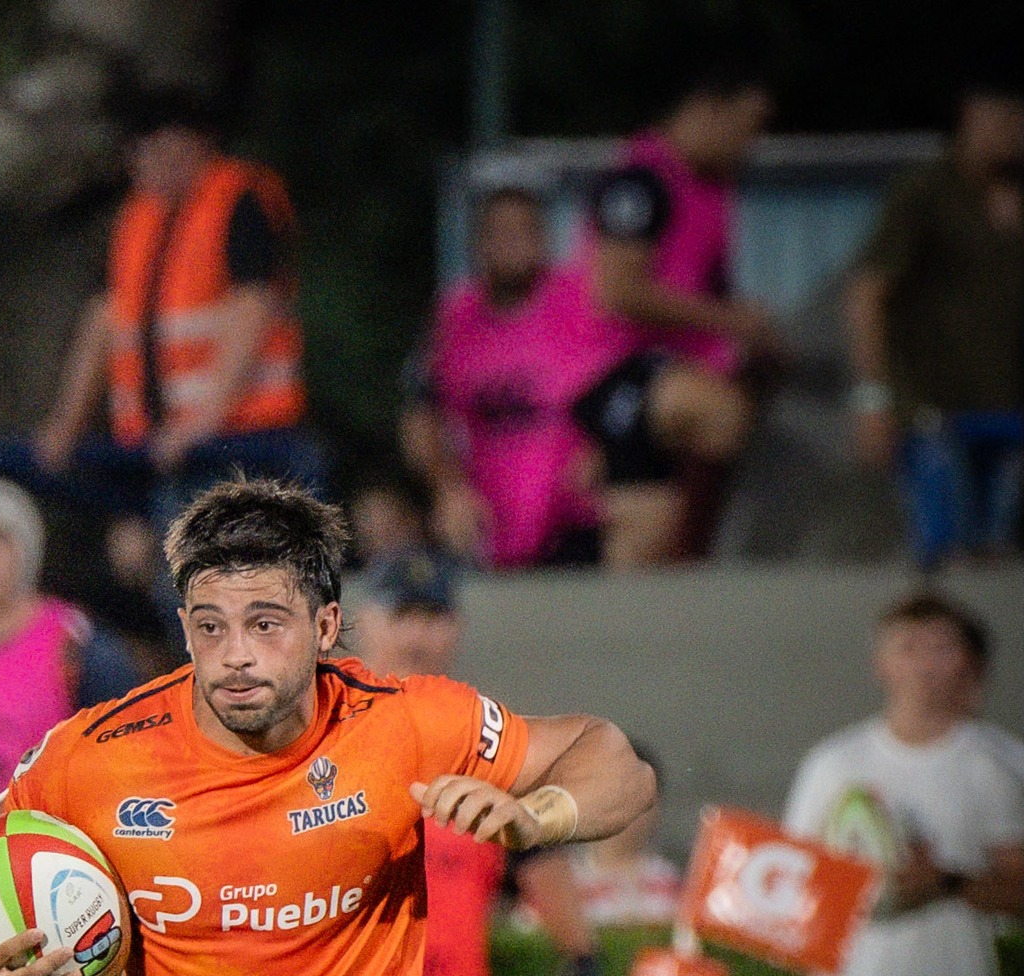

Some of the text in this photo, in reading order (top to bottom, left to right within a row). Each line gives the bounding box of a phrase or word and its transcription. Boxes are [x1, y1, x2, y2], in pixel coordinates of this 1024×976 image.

[96, 712, 173, 743] GEMSA
[289, 791, 367, 834] TARUCAS
[114, 828, 172, 838] canterbury
[219, 883, 278, 901] Grupo
[64, 894, 104, 938] SUPER RUGBY
